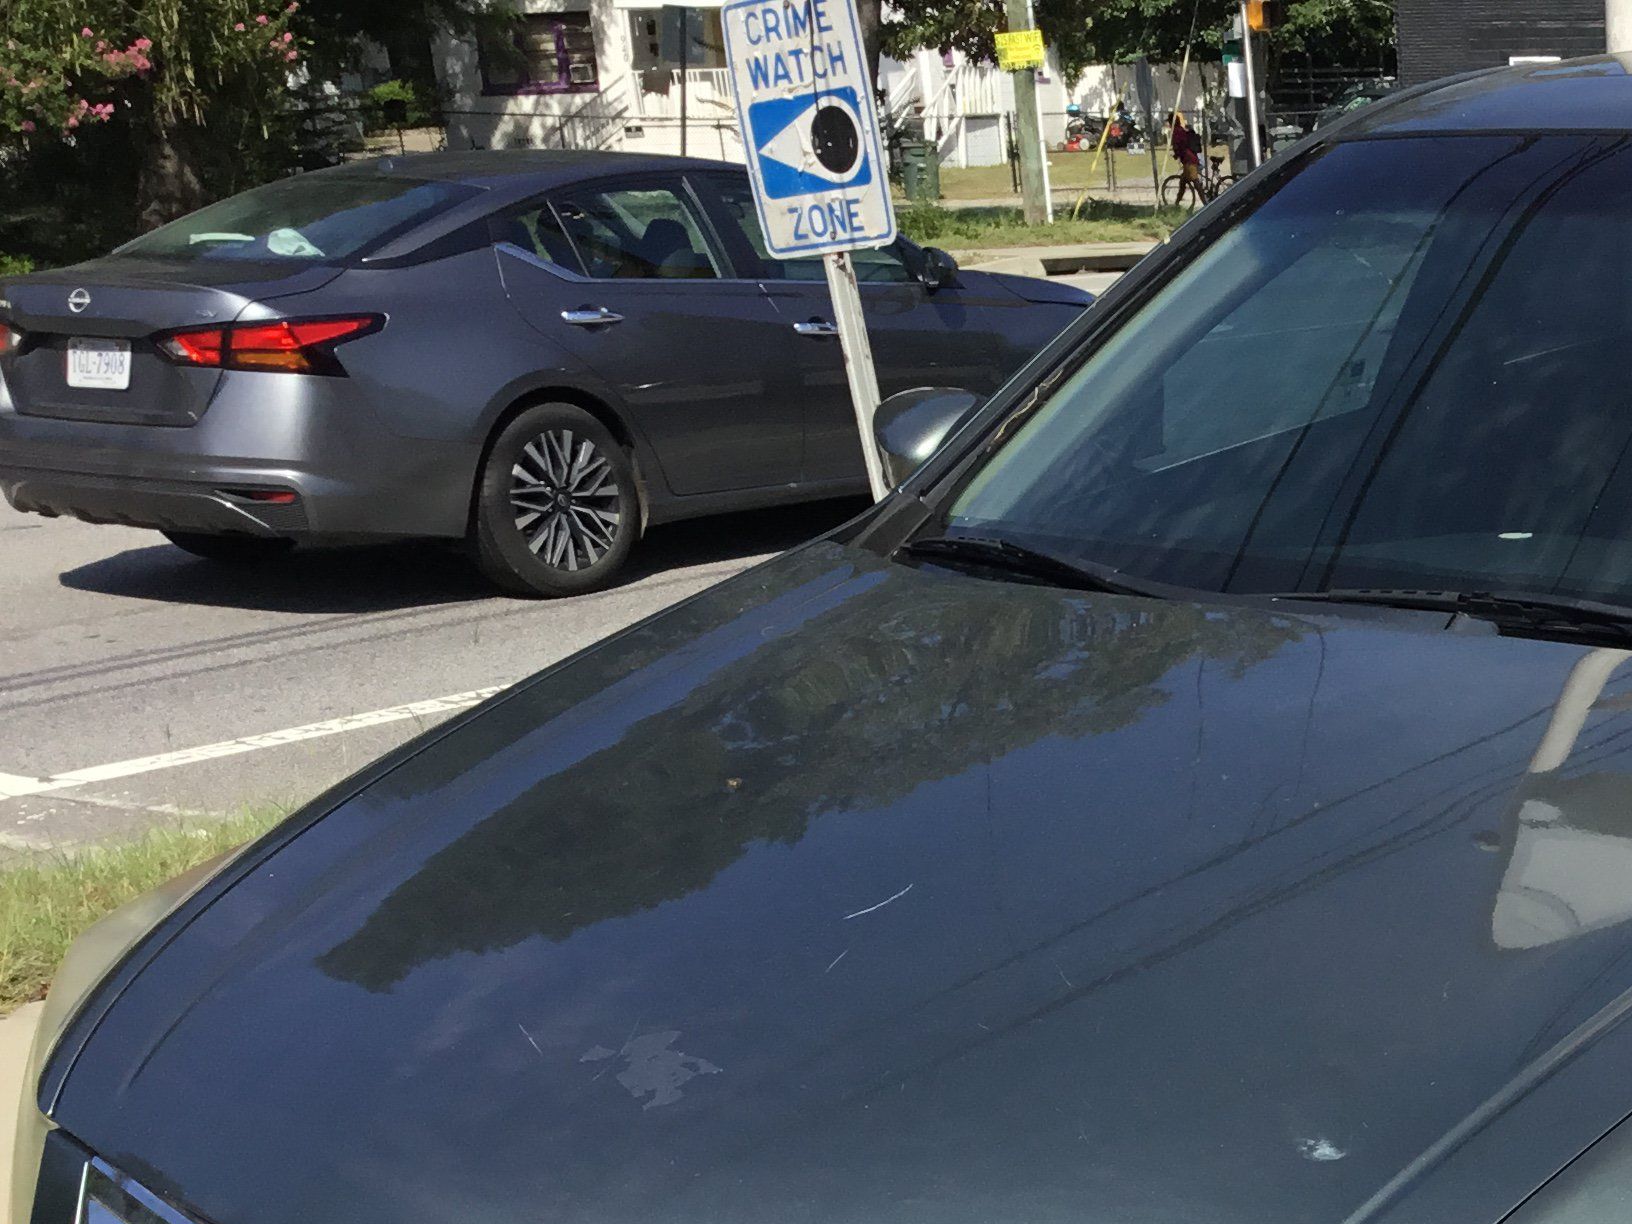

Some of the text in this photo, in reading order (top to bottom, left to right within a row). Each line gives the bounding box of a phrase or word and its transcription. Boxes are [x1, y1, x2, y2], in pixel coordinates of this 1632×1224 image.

[744, 0, 834, 46] CRIME
[746, 41, 848, 91] WATCH
[788, 198, 865, 241] ZONE
